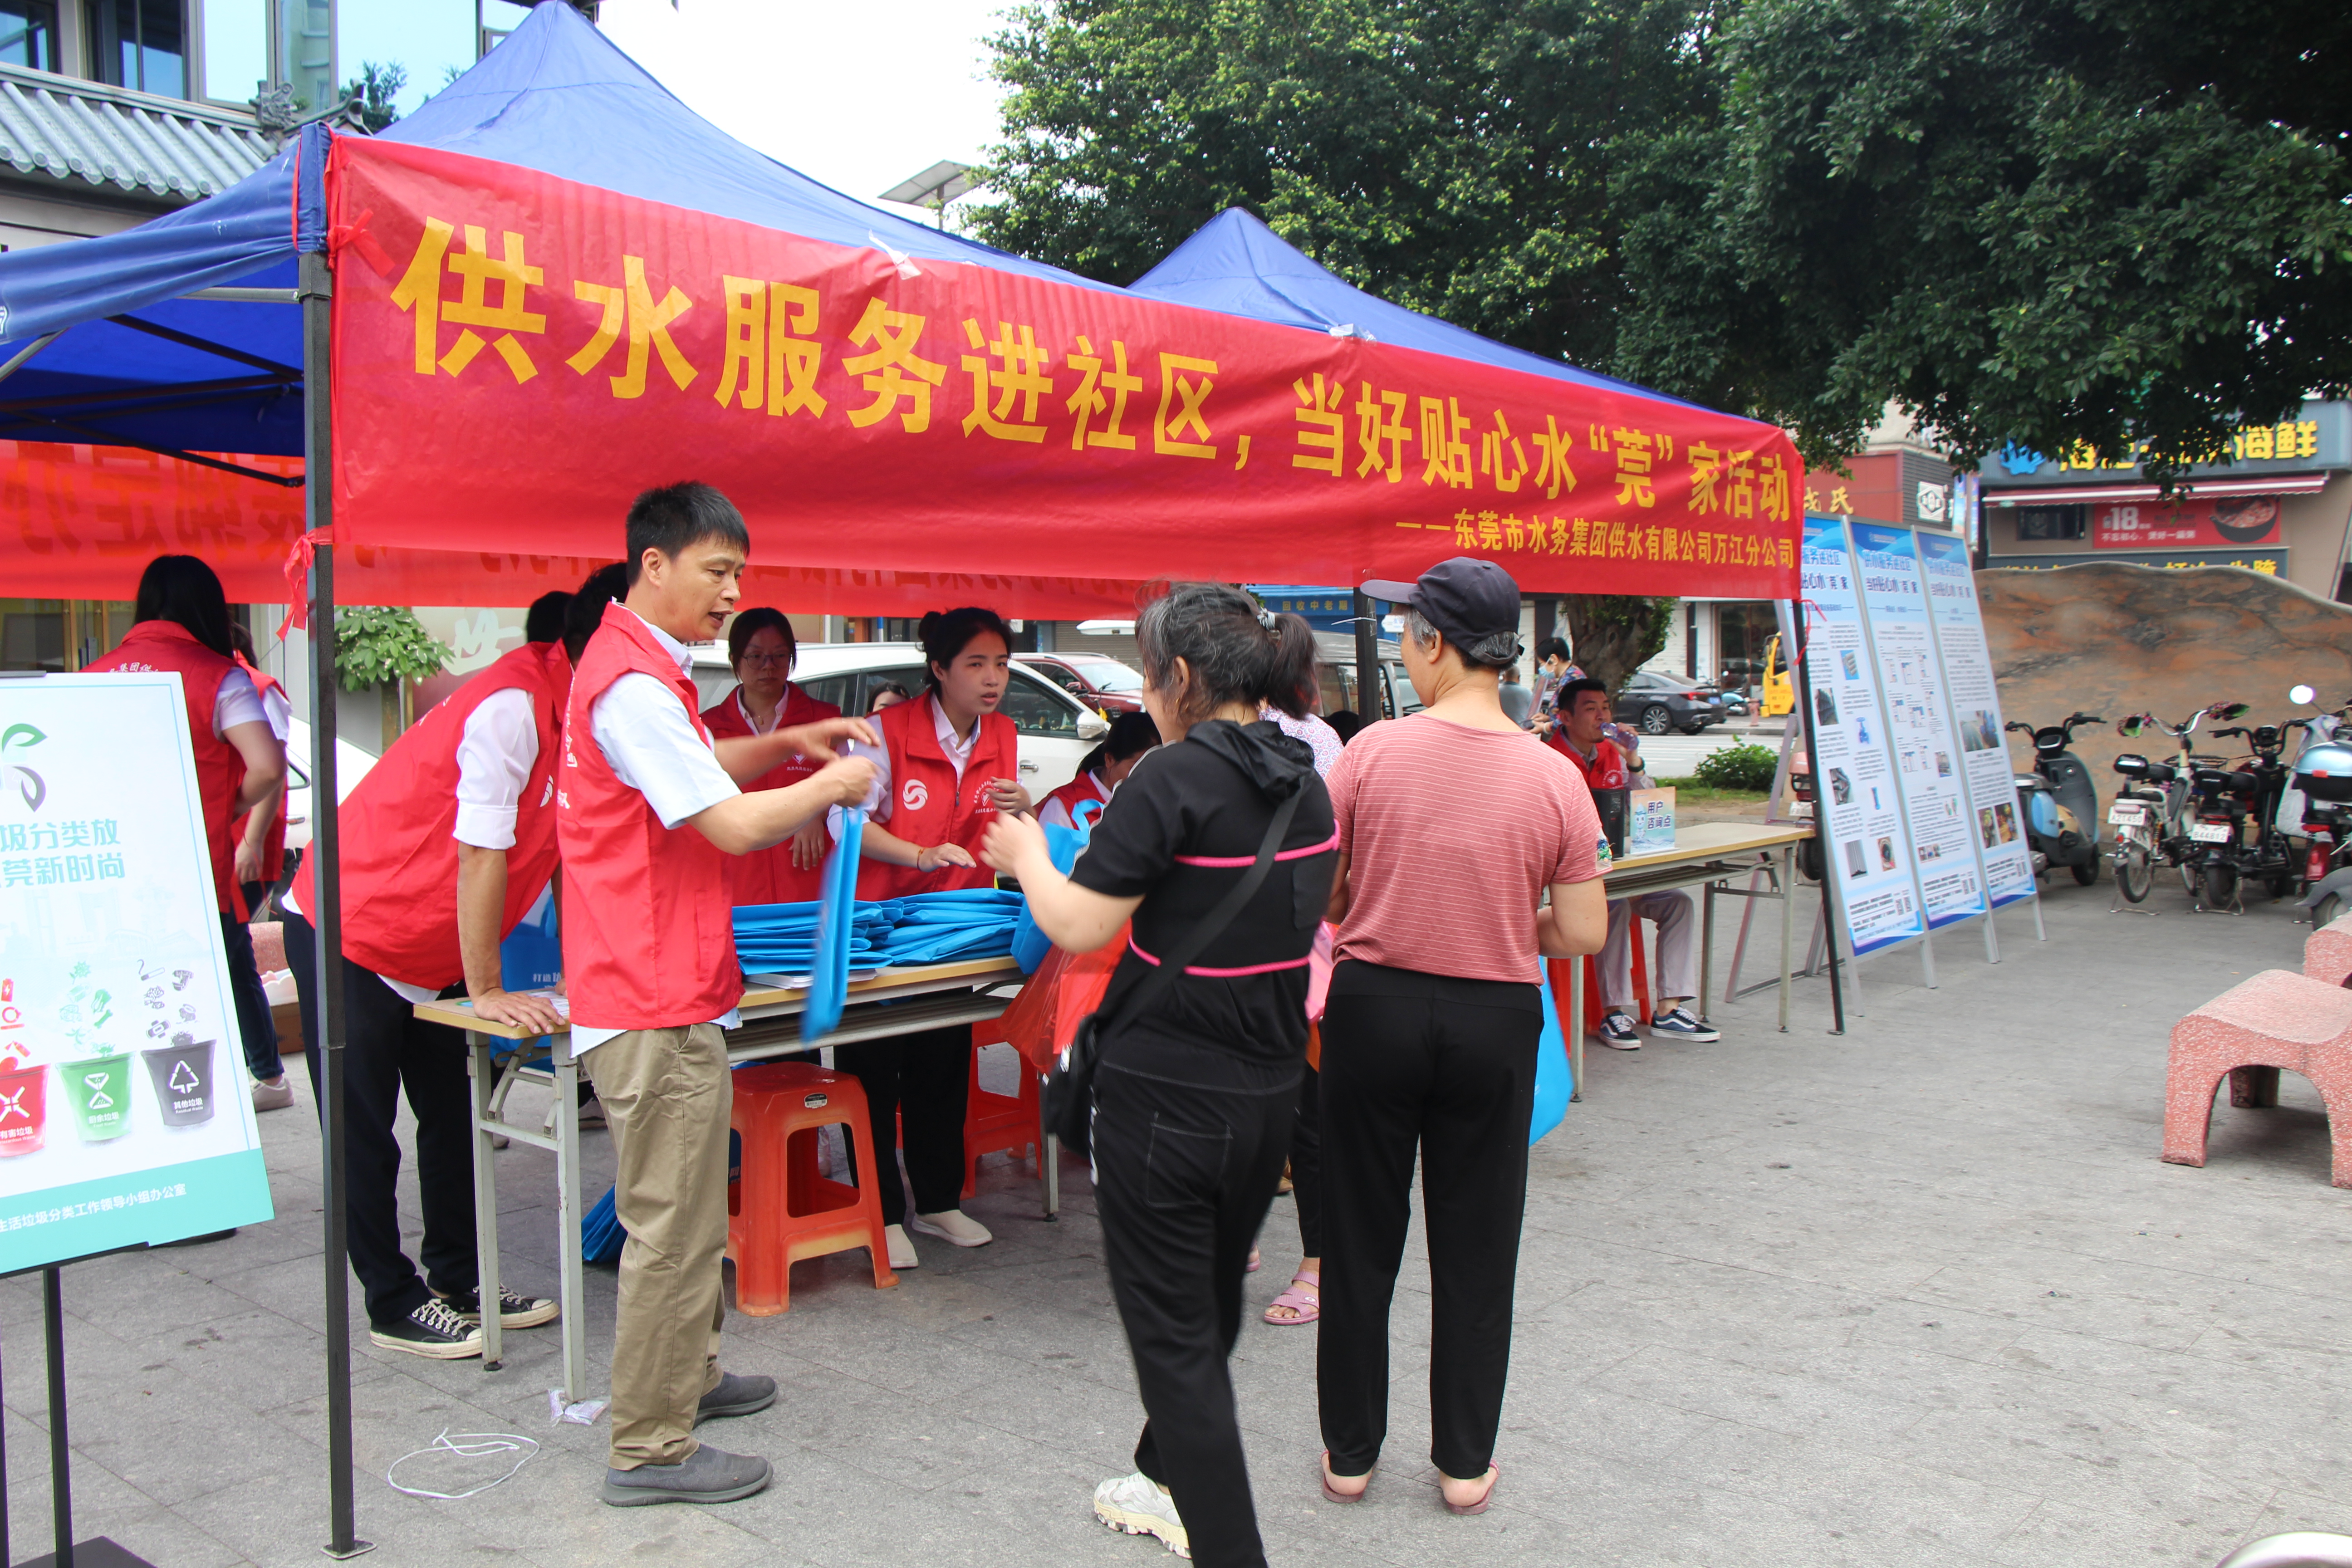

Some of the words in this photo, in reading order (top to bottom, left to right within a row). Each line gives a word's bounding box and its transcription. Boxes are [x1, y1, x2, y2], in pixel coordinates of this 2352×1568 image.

[2234, 421, 2318, 461] 海鲜
[2111, 507, 2138, 530] 18
[1647, 800, 1664, 815] 用户
[1647, 815, 1672, 830] 咨询点
[0, 818, 121, 852] 圾分类放
[2, 852, 125, 888] 莞新时尚
[174, 1097, 203, 1110] 其他垃圾
[88, 1112, 119, 1124] 厨余垃圾
[0, 1126, 34, 1139] 有害垃圾
